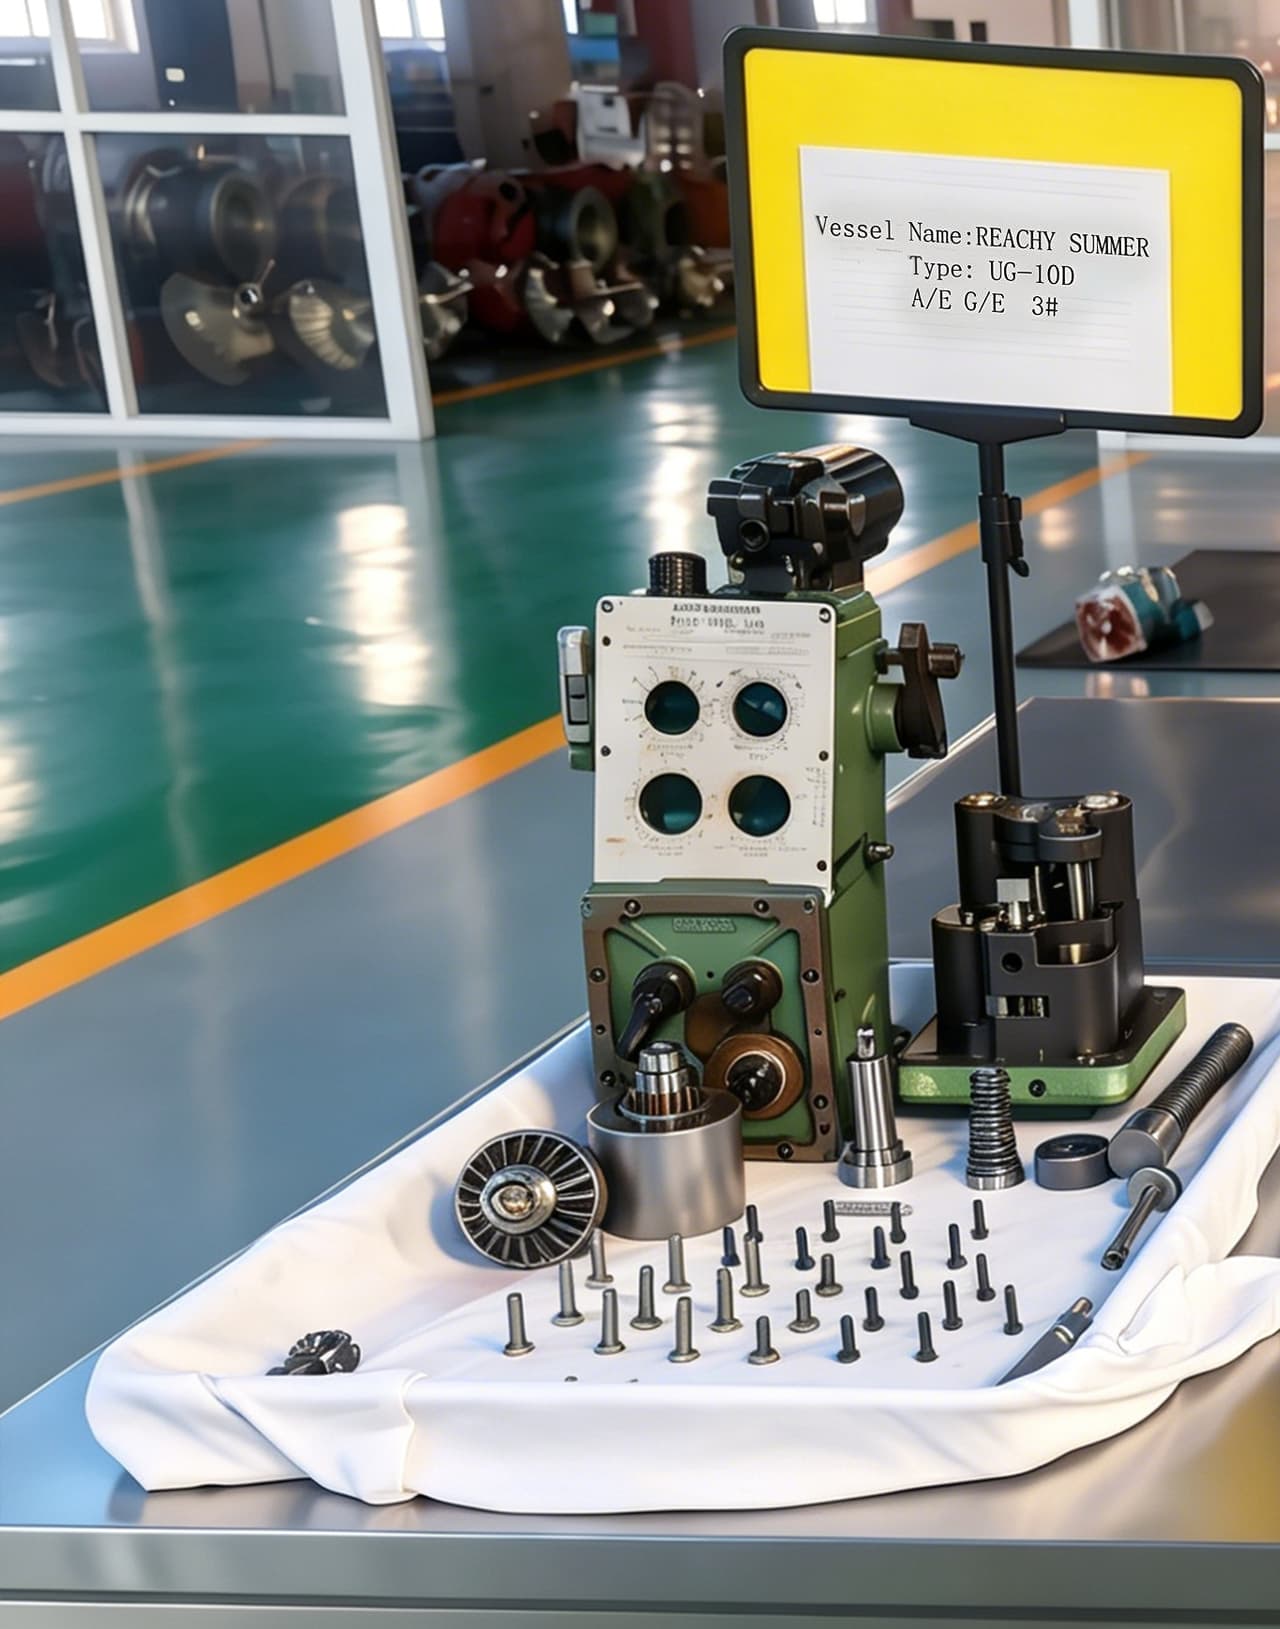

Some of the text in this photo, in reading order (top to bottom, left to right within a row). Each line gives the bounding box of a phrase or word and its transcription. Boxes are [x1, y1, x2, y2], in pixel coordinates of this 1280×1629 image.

[815, 215, 1151, 258] Vessel Name:REACHY SUMMER
[908, 254, 1076, 286] Type: UG-10D
[911, 287, 1060, 318] A/E G/E 3#
